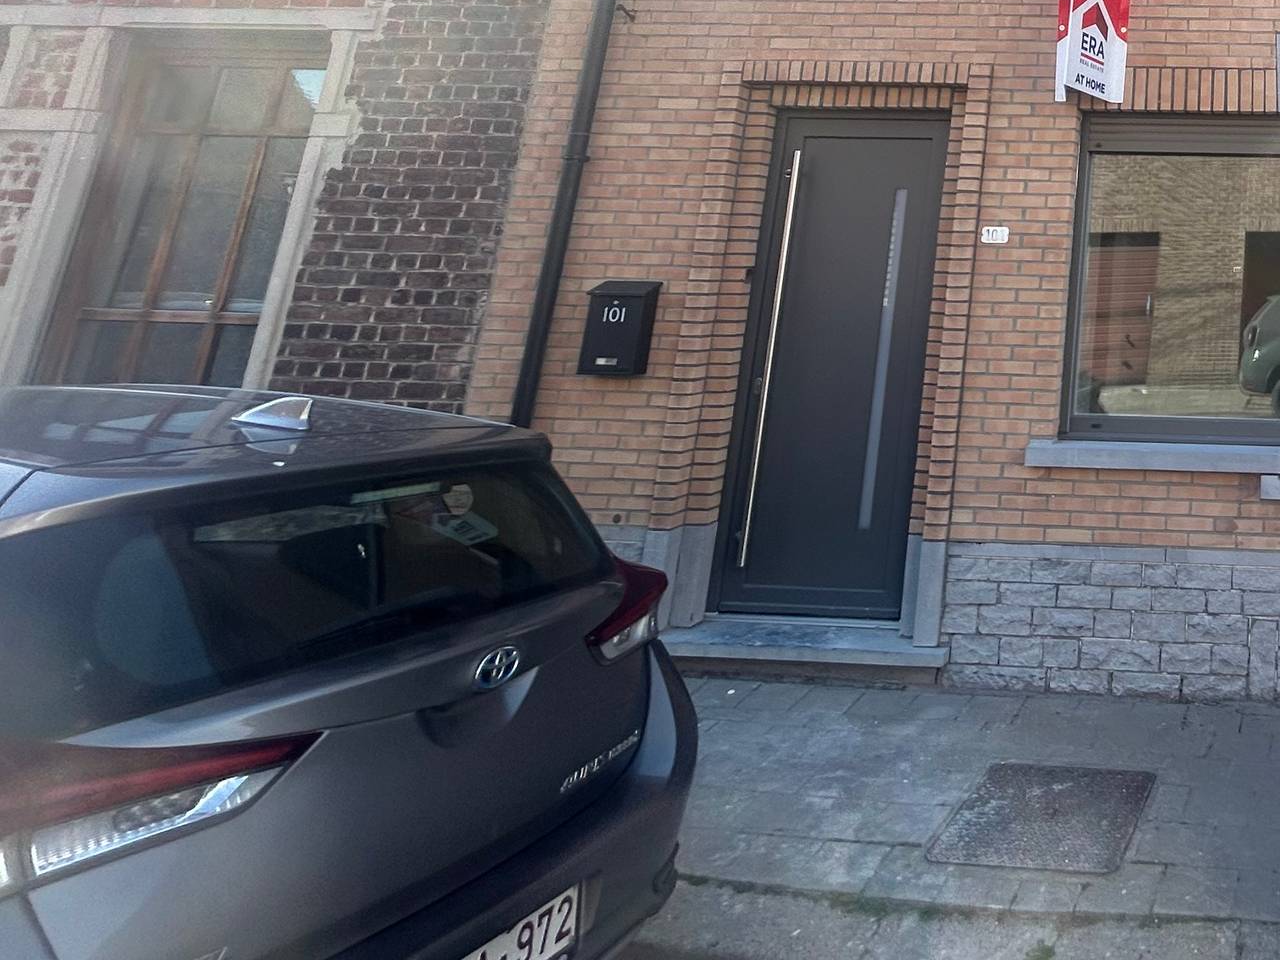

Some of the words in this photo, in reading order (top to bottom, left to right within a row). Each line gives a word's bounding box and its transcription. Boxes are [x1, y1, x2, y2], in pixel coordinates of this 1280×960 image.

[1081, 31, 1105, 60] ERA
[1075, 73, 1085, 86] AT
[1085, 77, 1106, 94] HOME
[602, 306, 626, 322] 101
